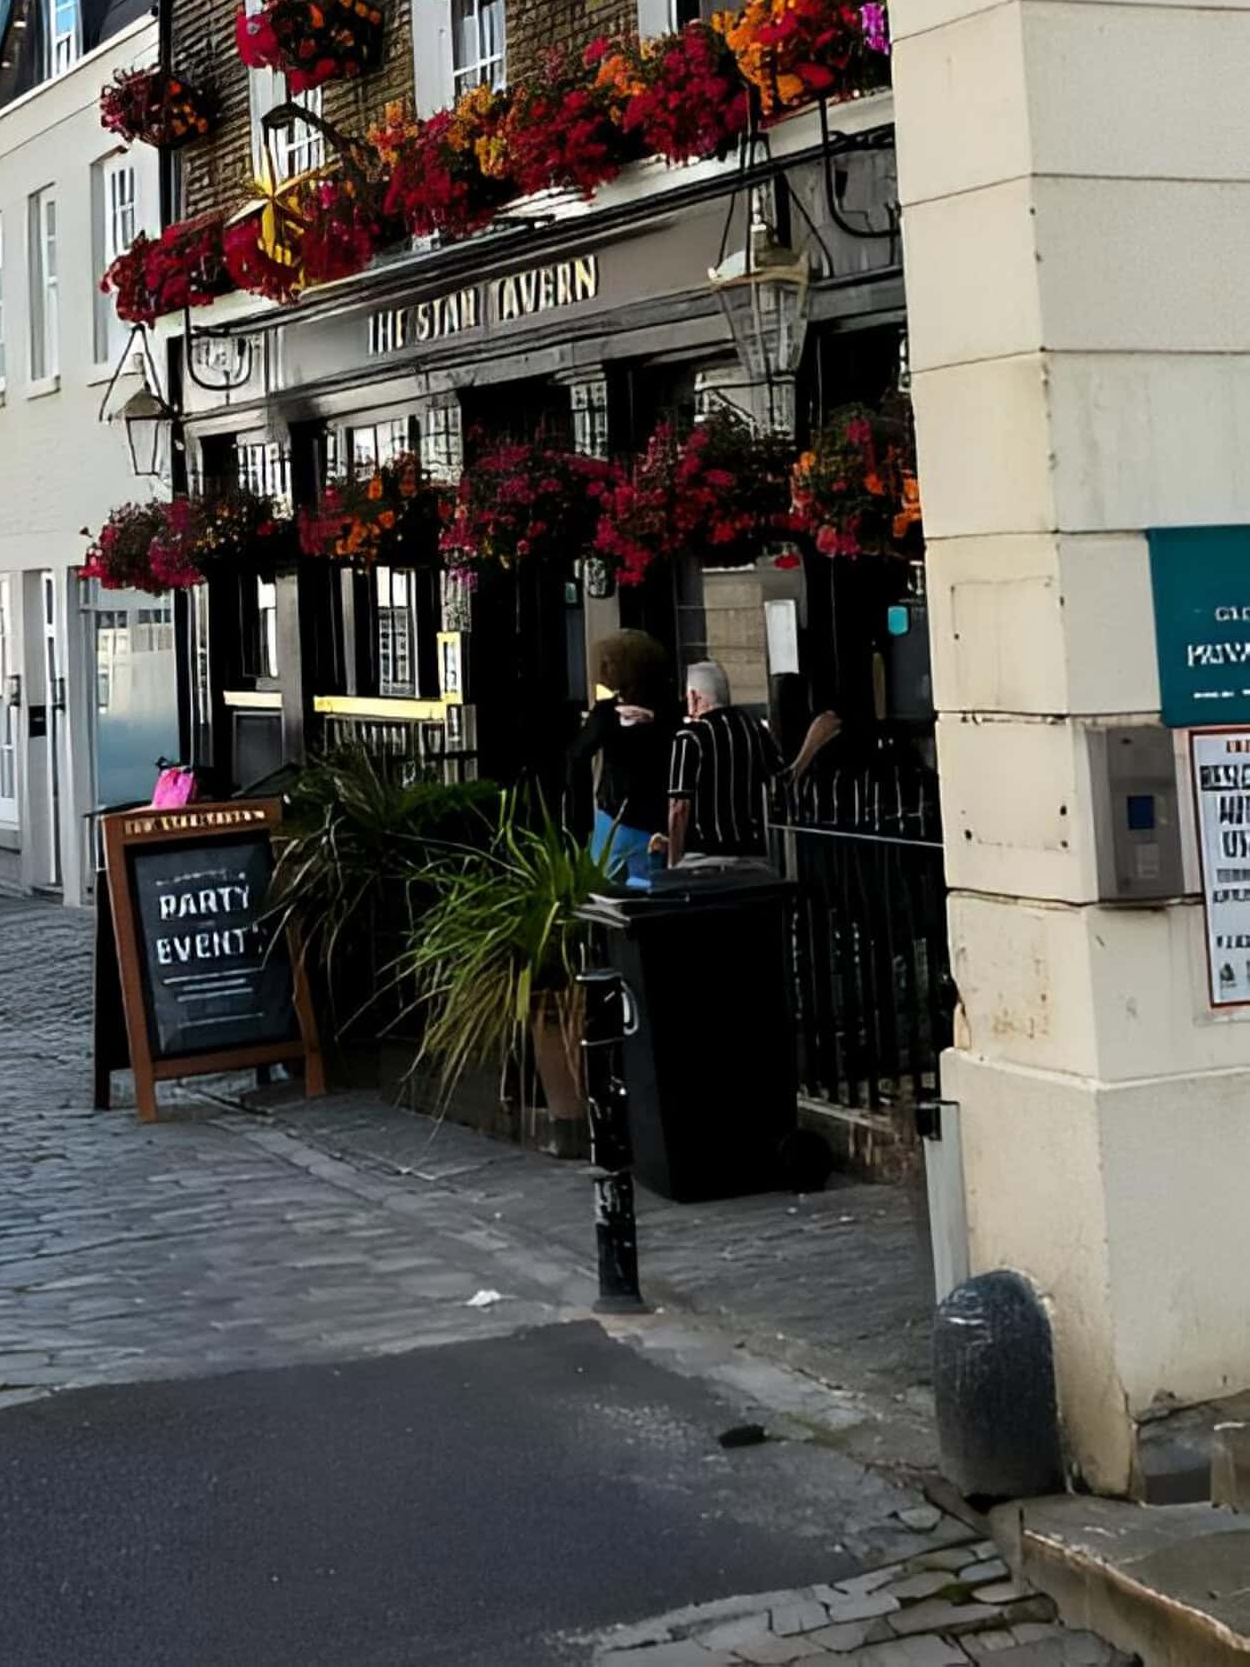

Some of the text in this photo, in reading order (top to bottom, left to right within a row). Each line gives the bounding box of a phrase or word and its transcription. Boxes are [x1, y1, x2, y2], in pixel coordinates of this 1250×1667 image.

[488, 255, 597, 320] TAVERN
[160, 885, 250, 920] PARTY
[157, 924, 266, 964] EVENT
